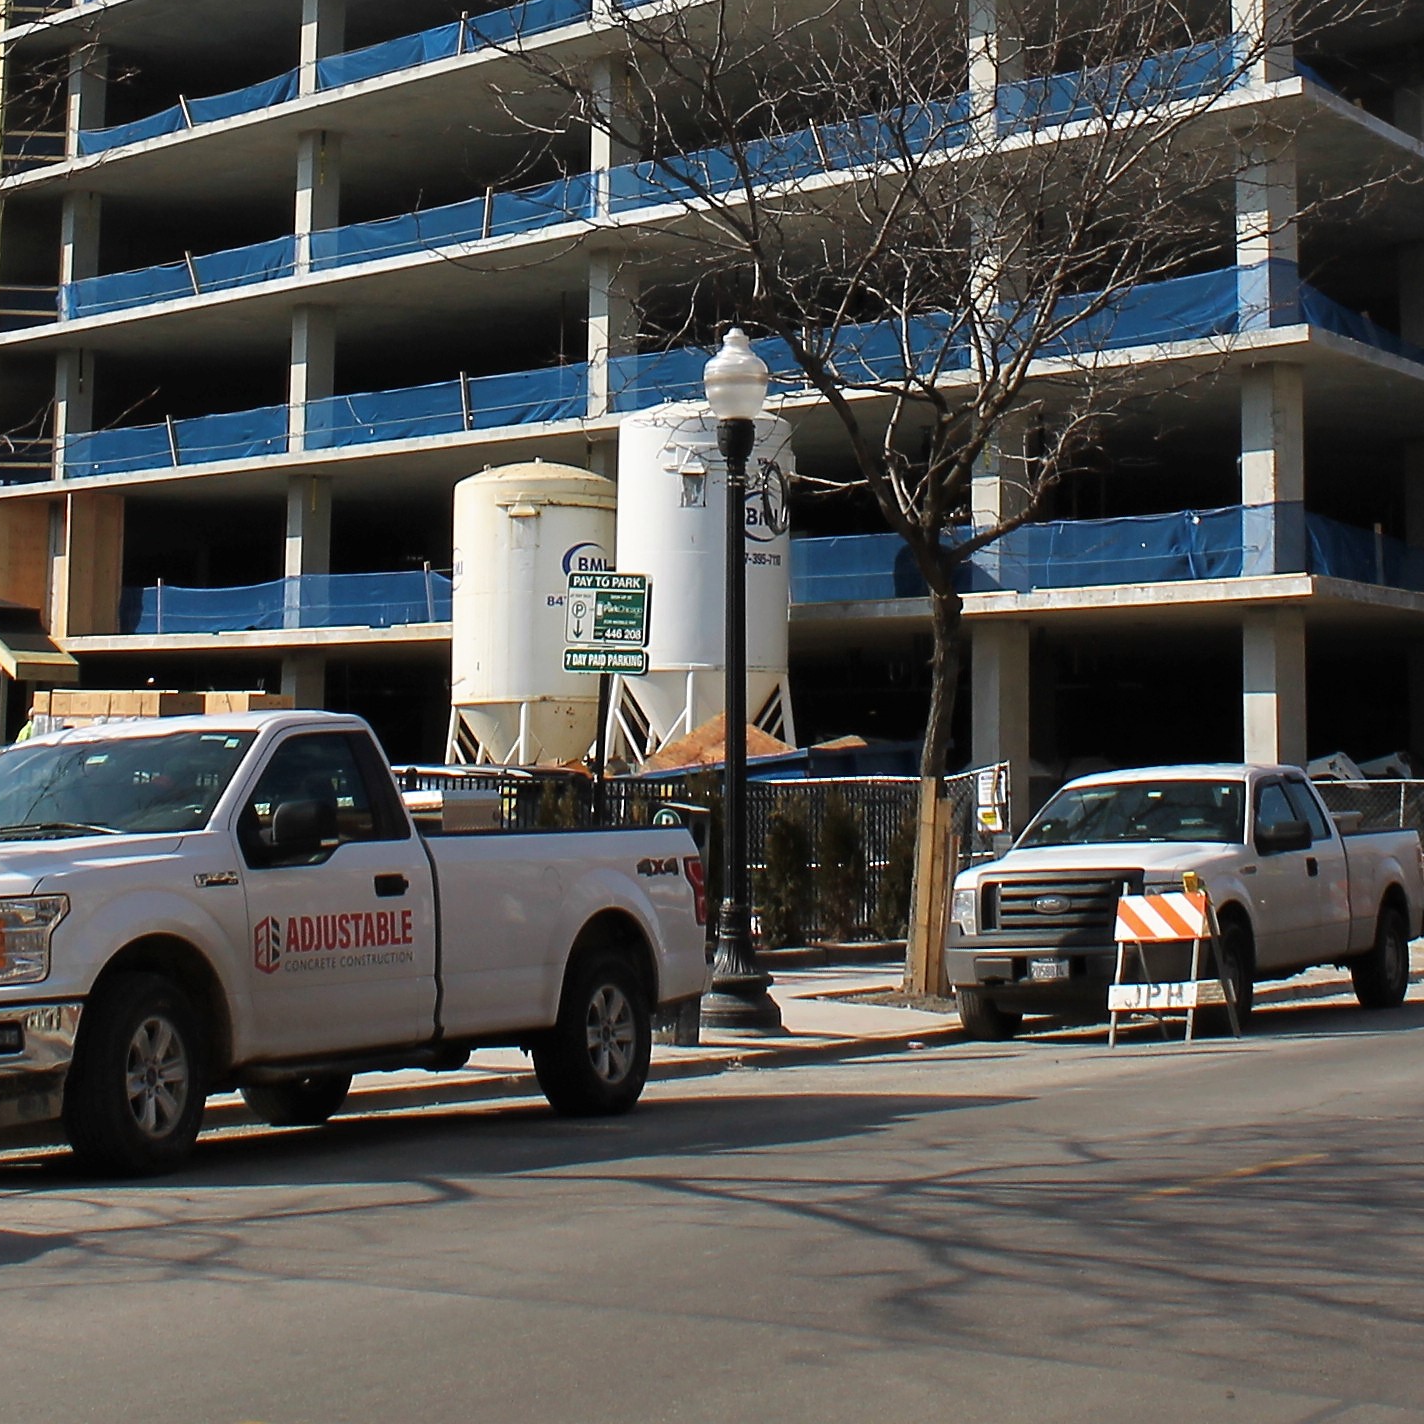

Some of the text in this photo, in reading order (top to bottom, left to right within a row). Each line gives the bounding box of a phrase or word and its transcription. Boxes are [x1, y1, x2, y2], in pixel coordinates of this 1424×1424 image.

[578, 557, 607, 572] BMI
[573, 576, 641, 588] PAY TO PARK
[547, 596, 566, 606] 84
[566, 654, 643, 667] 7 DAY PAID PARKING
[285, 909, 413, 953] ADJUSTABLE
[284, 951, 414, 972] CONCRETE CONSTRUCTION
